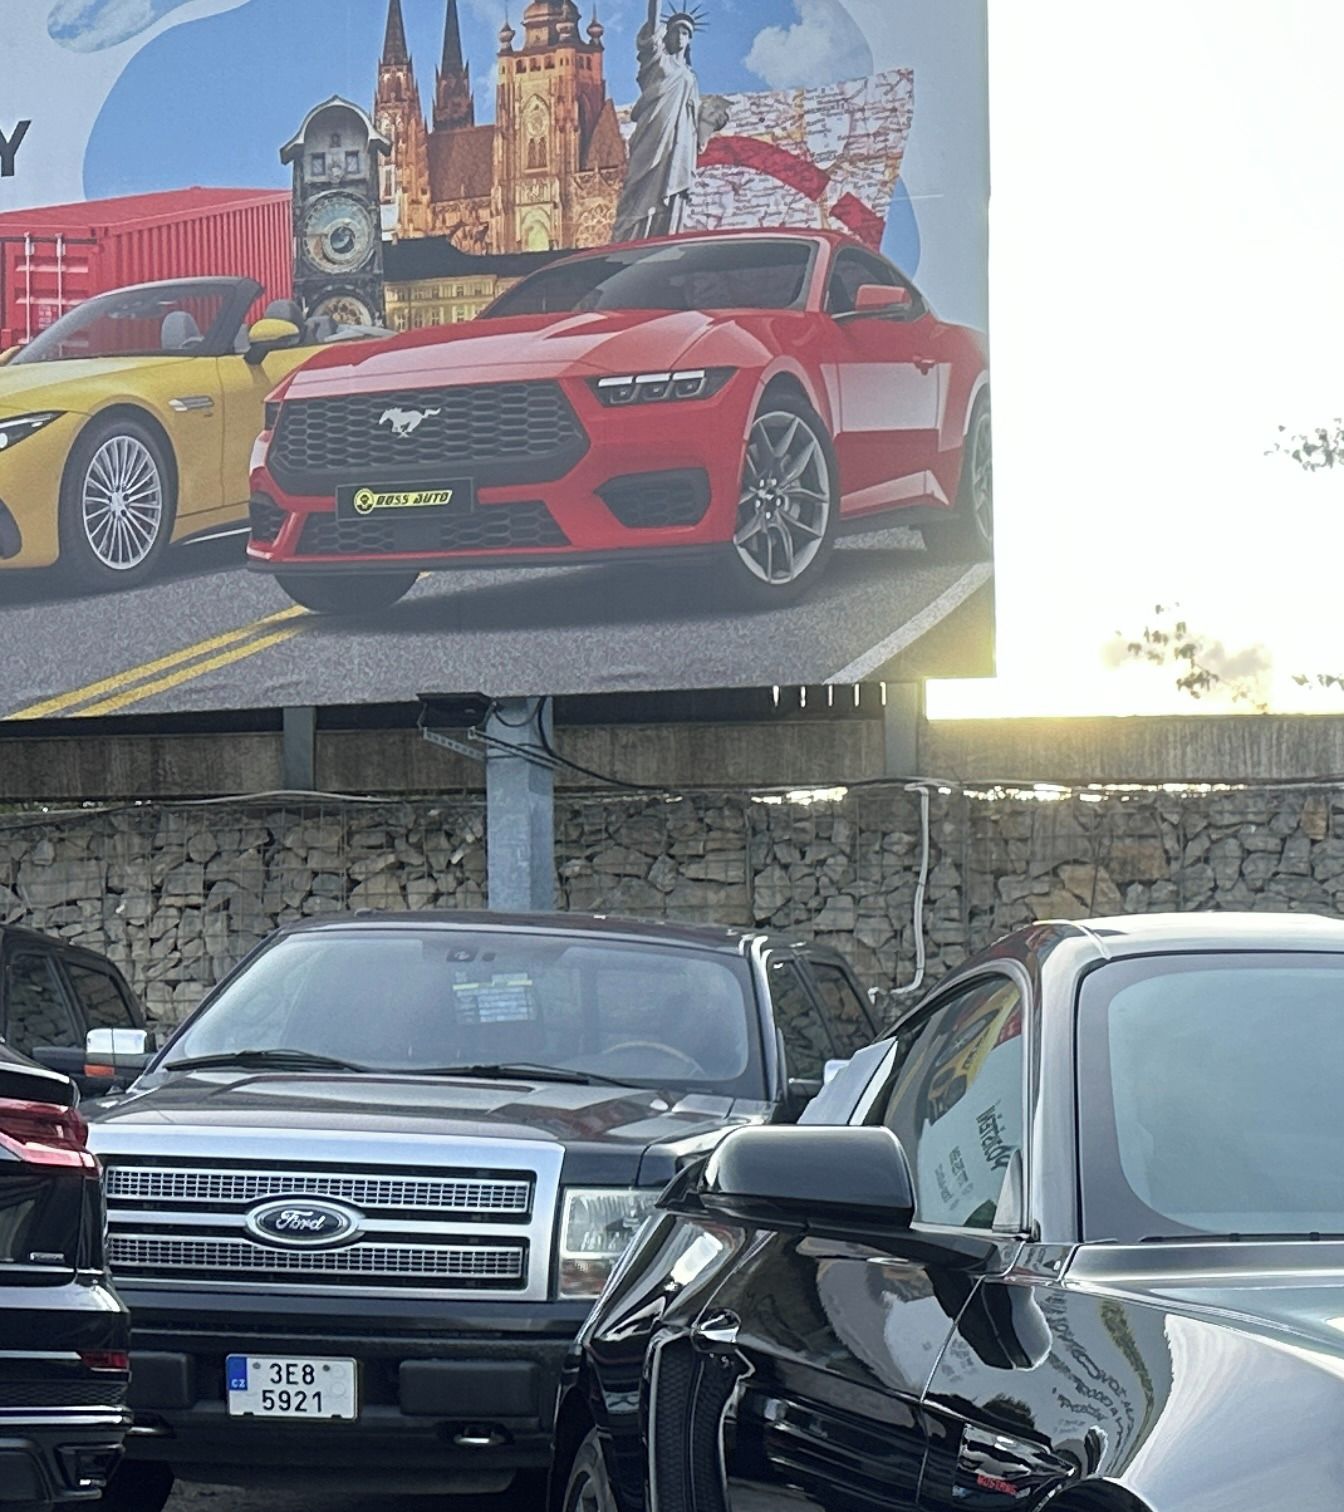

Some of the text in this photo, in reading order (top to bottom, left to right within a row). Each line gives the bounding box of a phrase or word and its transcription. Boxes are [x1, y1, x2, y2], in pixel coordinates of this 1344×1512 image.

[413, 491, 450, 504] AUTO
[275, 1209, 327, 1231] Ford
[231, 1379, 246, 1388] CZ
[269, 1363, 315, 1385] 3E8
[262, 1389, 322, 1412] 5921
